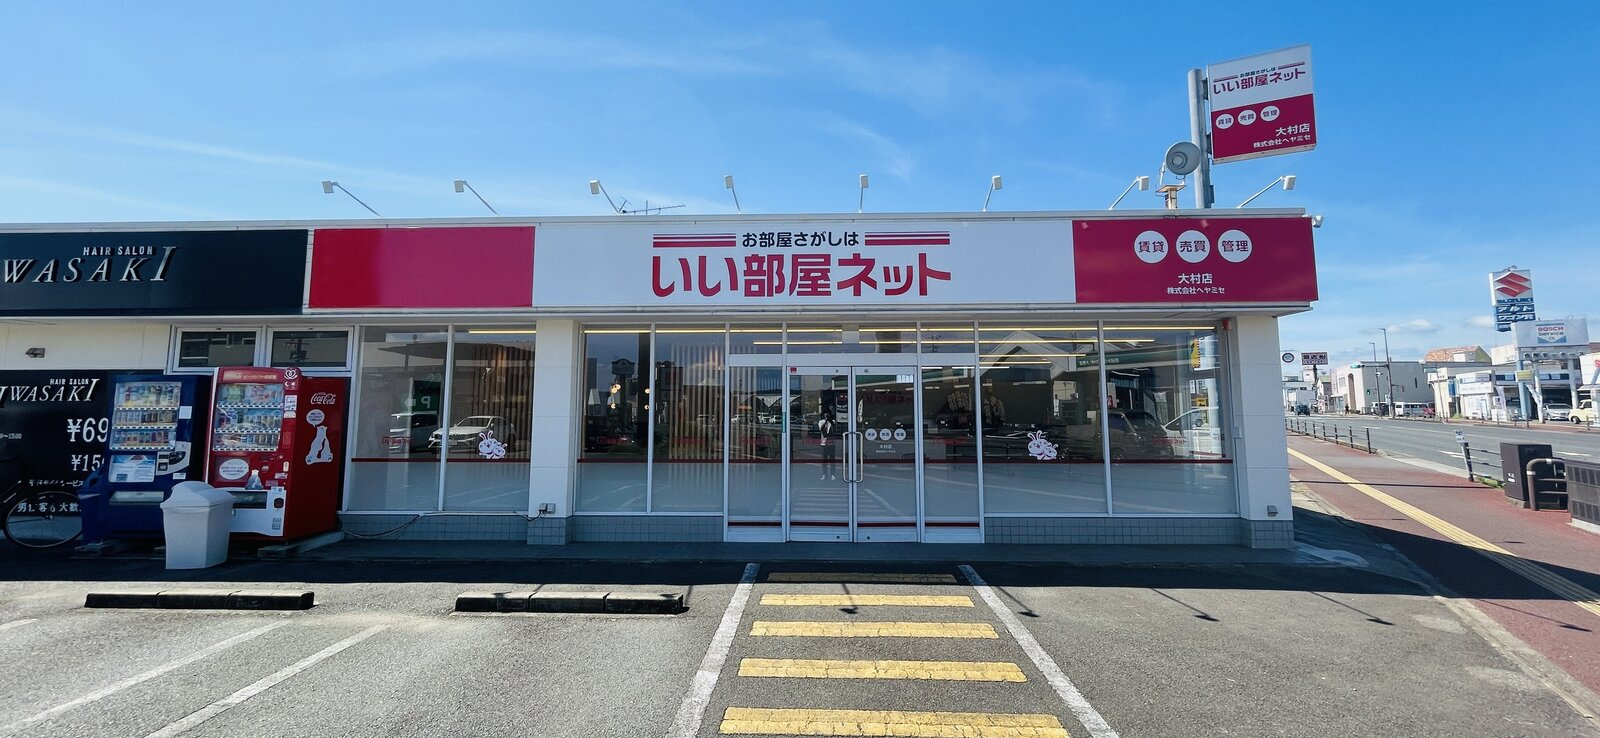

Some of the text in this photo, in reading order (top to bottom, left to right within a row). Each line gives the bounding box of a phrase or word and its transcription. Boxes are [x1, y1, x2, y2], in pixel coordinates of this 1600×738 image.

[1240, 67, 1276, 78] お部屋さがしは
[1213, 68, 1306, 94] いい部屋ネット
[1275, 123, 1310, 137] 大村店
[1253, 134, 1311, 148] 株式会社ヘヤミセ
[742, 231, 860, 248] お部屋さがしは
[1138, 240, 1249, 253] 賃貸 売買 管理
[83, 246, 153, 256] HAIR SALON
[4, 246, 176, 283] WASAKI
[652, 252, 952, 297] いい部屋ネット
[1178, 273, 1213, 284] 大村店
[1166, 286, 1225, 295] 株式会社ヘヤミセ
[71, 454, 104, 472] ¥15
